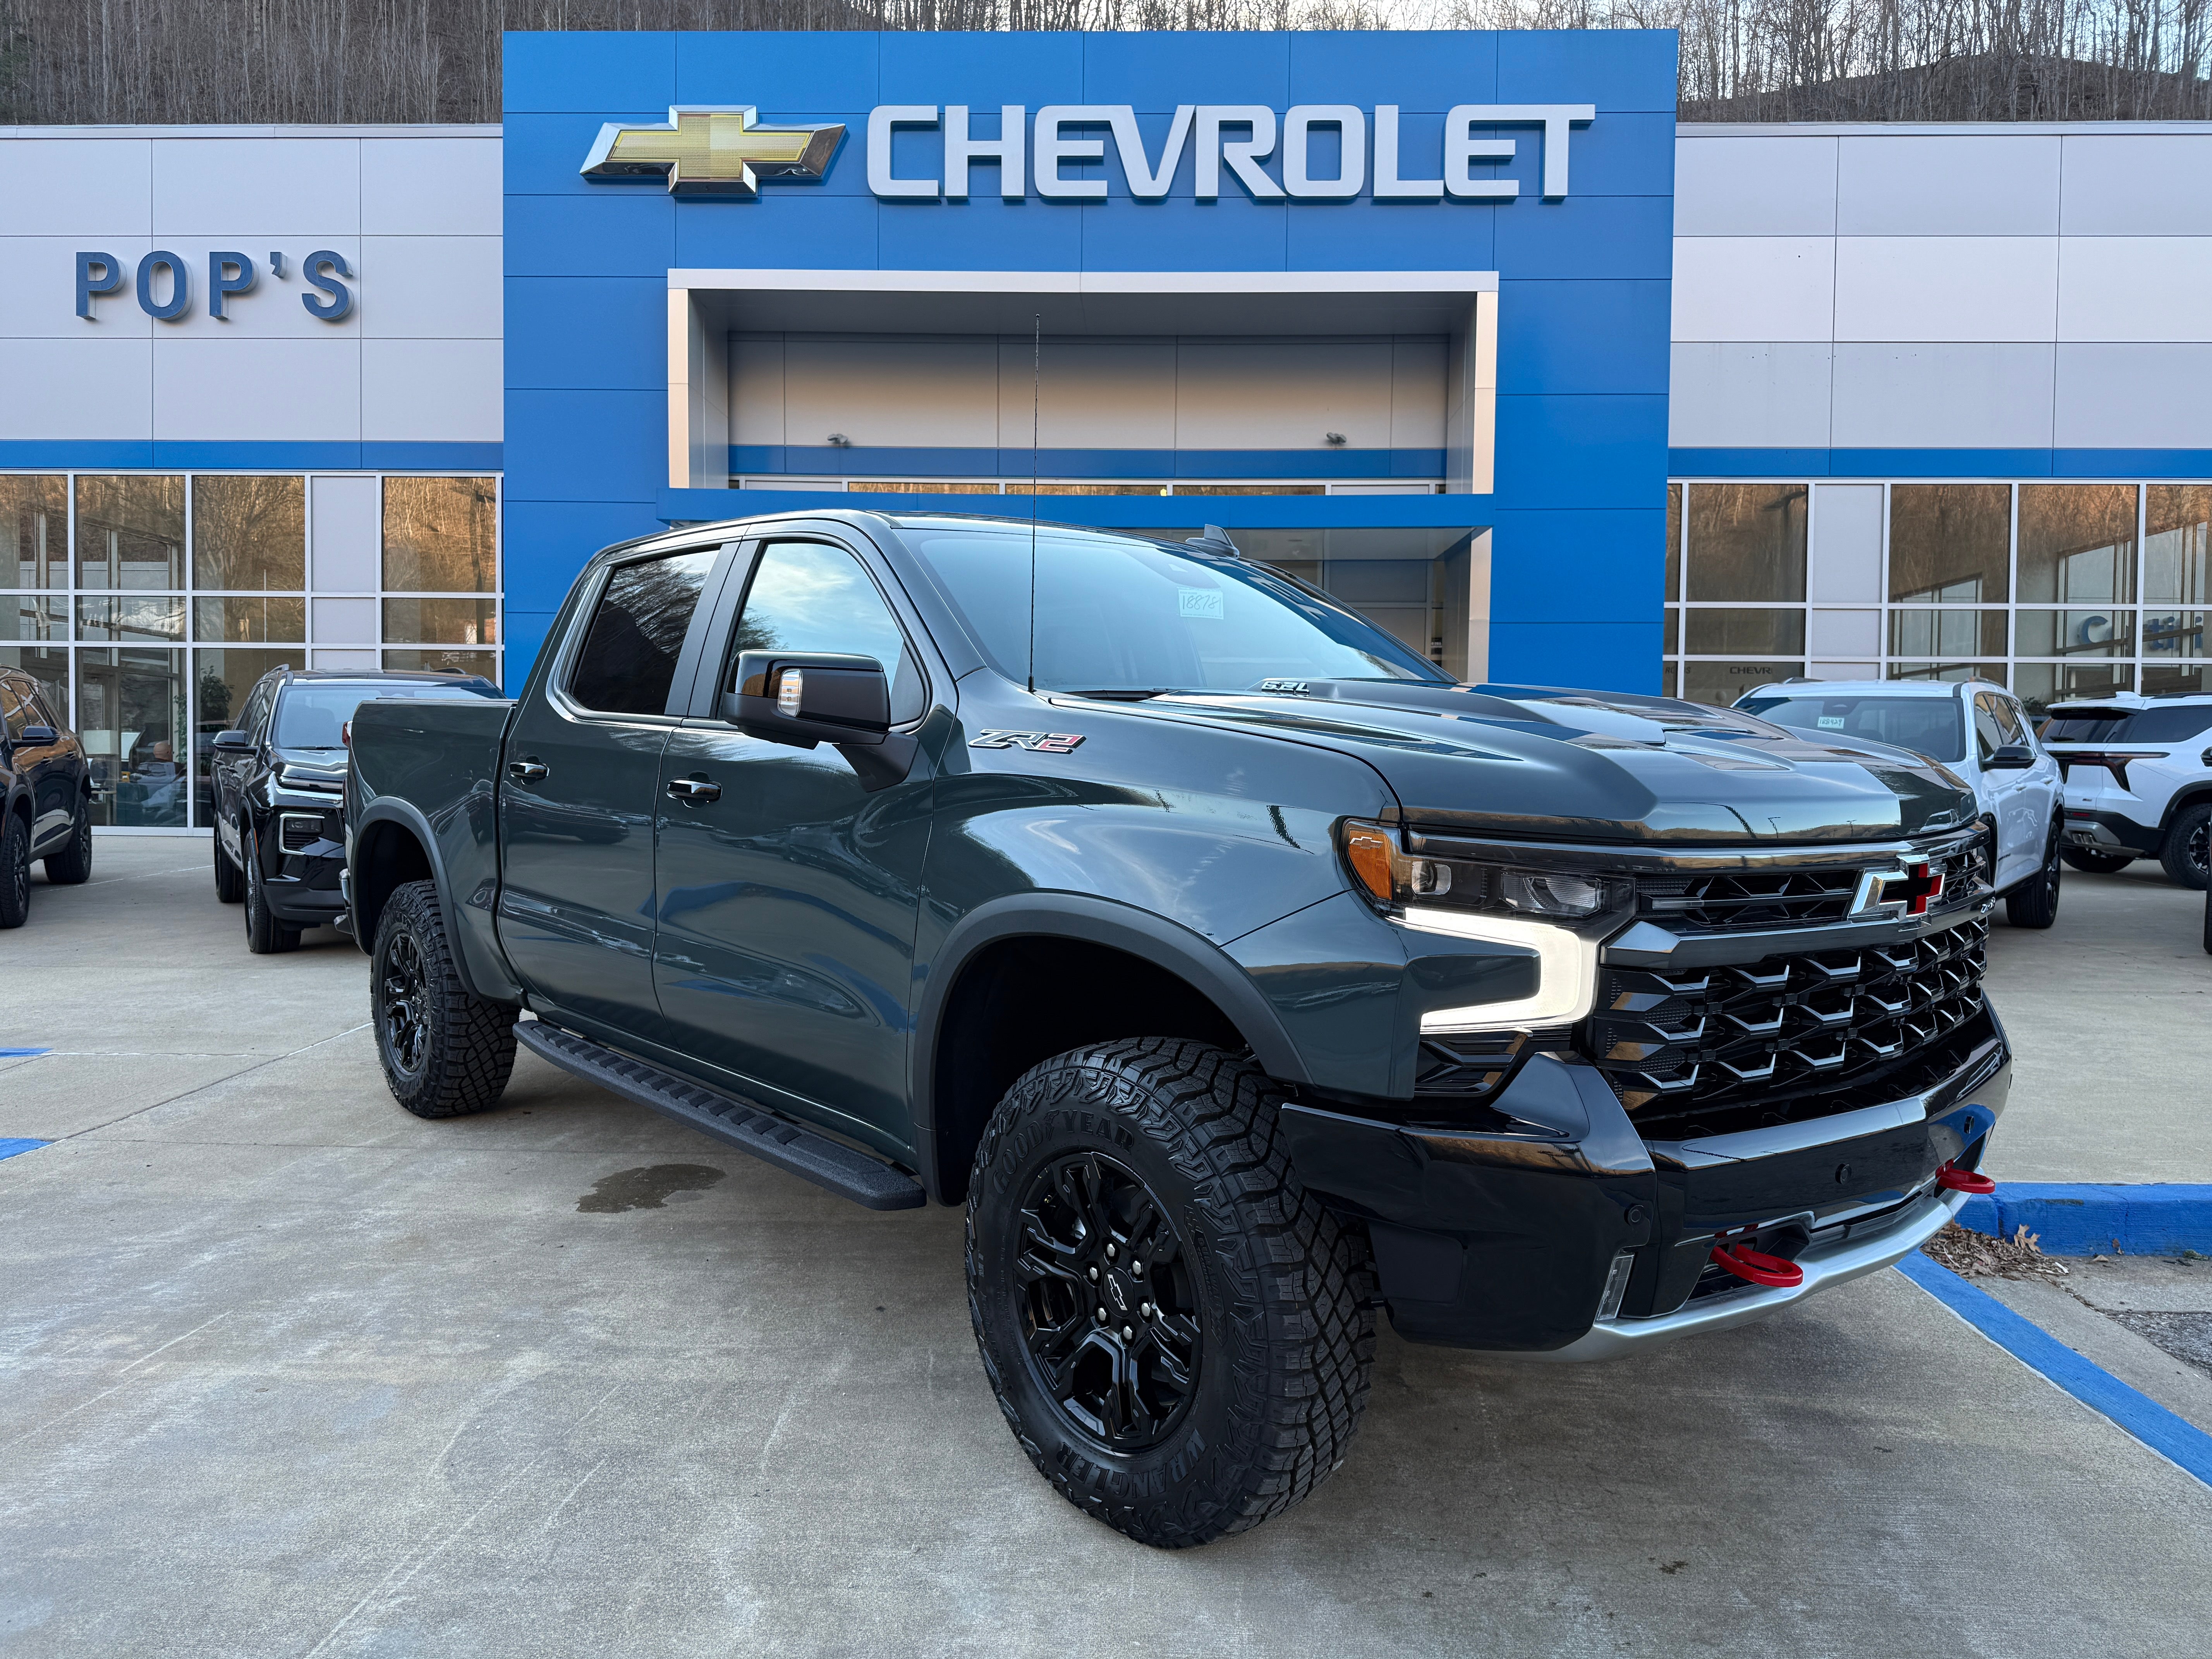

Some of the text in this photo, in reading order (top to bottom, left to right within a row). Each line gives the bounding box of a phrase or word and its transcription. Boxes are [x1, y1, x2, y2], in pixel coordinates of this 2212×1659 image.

[867, 104, 1595, 200] CHEVROLET
[76, 250, 353, 320] POP'S
[1261, 681, 1310, 698] 6.2L
[968, 728, 1087, 754] ZR2
[1055, 1426, 1208, 1498] WRANGLER
